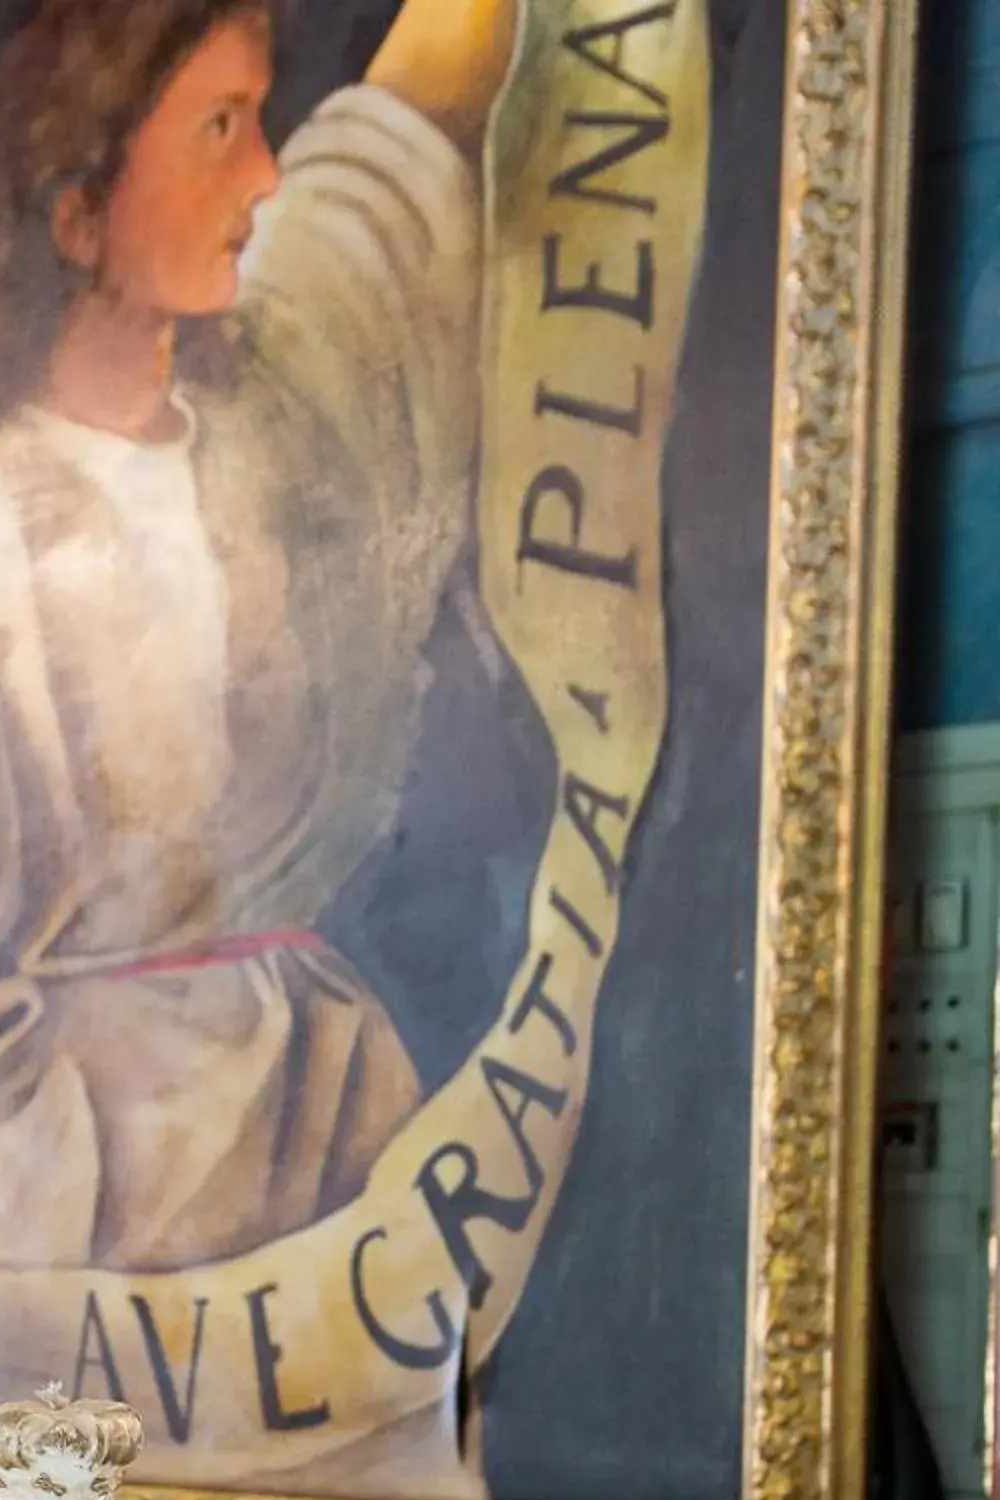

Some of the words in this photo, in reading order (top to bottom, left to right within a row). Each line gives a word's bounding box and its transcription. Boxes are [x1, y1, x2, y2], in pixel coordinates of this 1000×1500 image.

[71, 1282, 331, 1445] AVE
[350, 770, 631, 1371] GRATIA
[515, 0, 677, 597] PLENA
